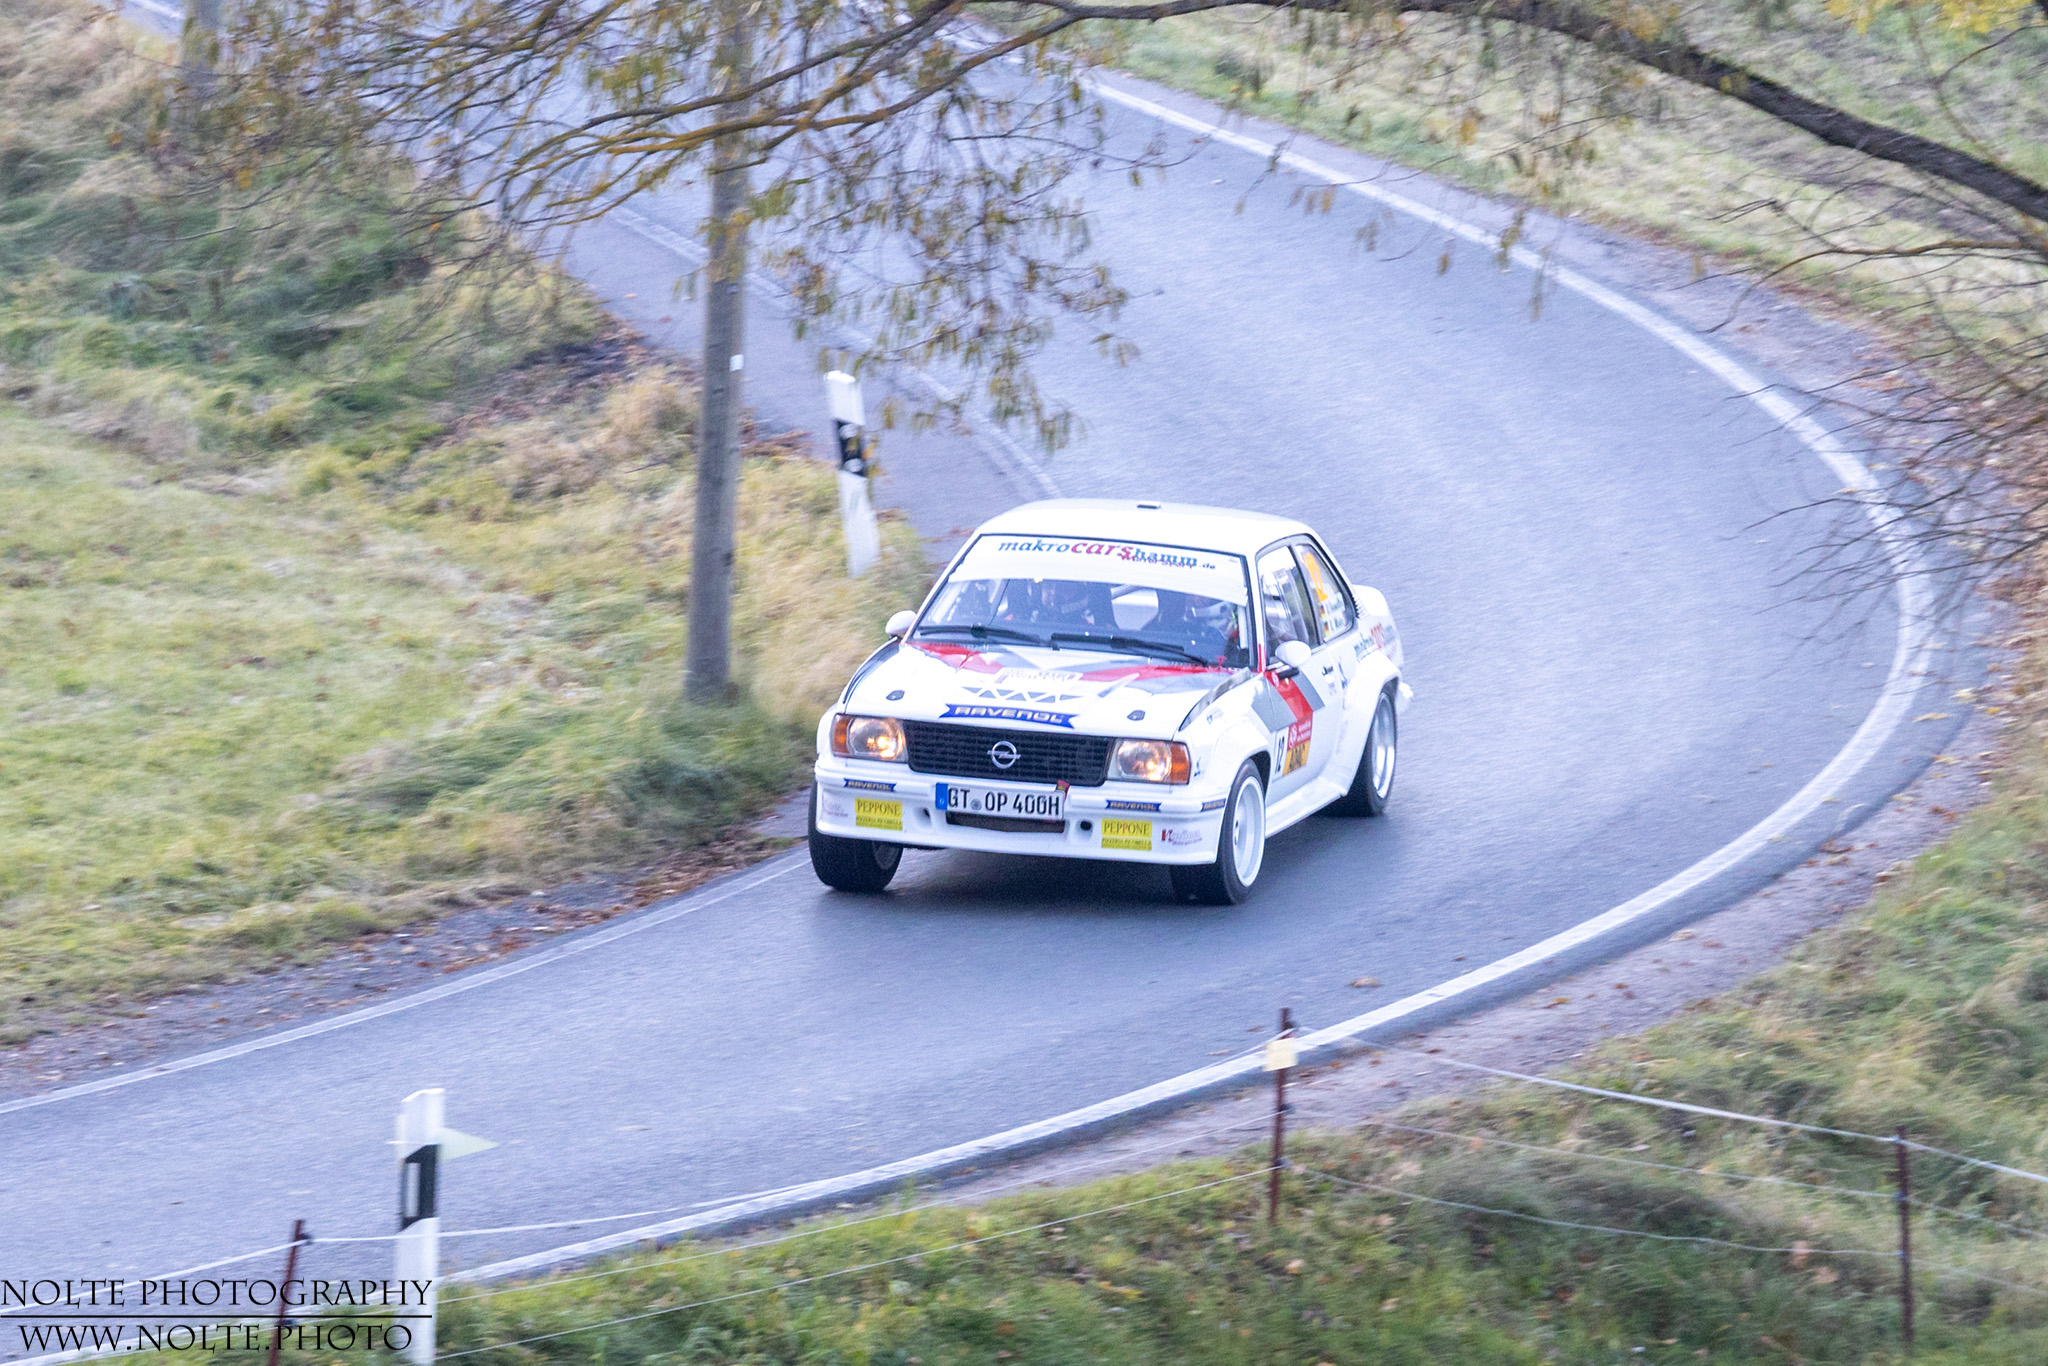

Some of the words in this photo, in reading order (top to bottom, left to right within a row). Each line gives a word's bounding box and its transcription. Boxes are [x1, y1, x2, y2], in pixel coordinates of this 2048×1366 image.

[954, 705, 1062, 724] RAVENOL
[848, 780, 891, 791] RAVENOL
[857, 799, 901, 817] PEPPONE
[948, 787, 970, 808] GT
[985, 791, 1008, 812] OP
[1013, 793, 1060, 816] 400H
[1110, 801, 1156, 811] RAVENOL
[1103, 821, 1151, 837] PEPPONE
